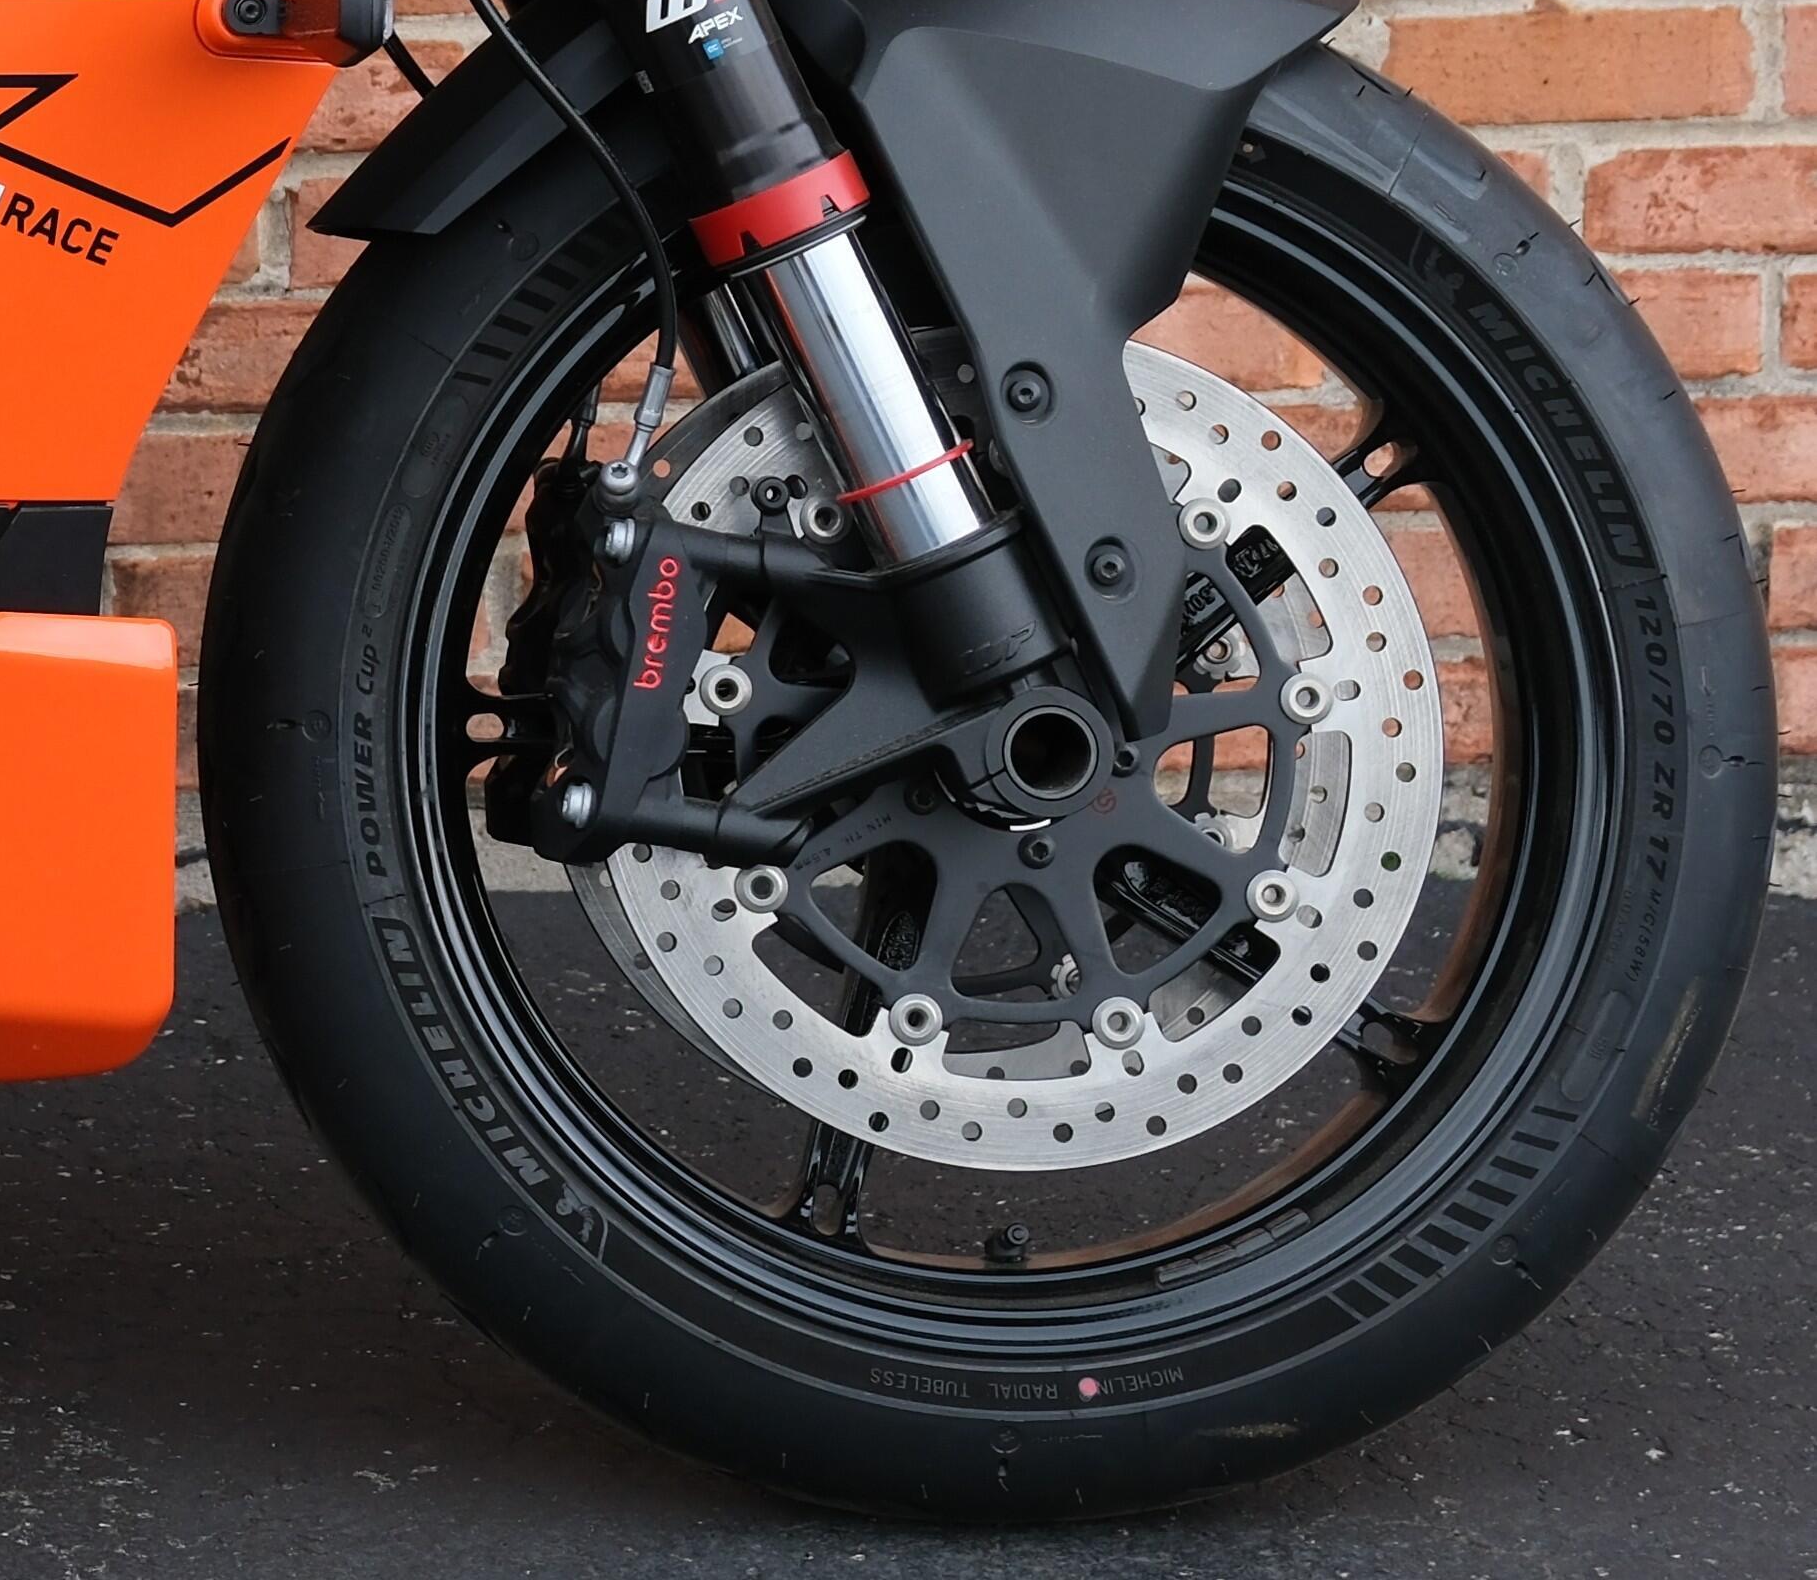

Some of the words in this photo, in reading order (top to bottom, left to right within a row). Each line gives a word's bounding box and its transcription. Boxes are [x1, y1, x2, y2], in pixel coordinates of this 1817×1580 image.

[687, 5, 744, 45] APEX
[0, 192, 120, 267] RACE
[1467, 301, 1646, 558] MICHELIN
[632, 557, 681, 690] brembo
[355, 643, 381, 696] Cup
[1633, 595, 1676, 747] 120/70
[353, 711, 389, 878] POWER
[1651, 760, 1677, 822] ZR
[1645, 834, 1670, 884] 17
[381, 927, 552, 1187] MICHELIN
[868, 1366, 972, 1399] TUBELESS
[988, 1381, 1060, 1401] RADIAL
[1096, 1366, 1184, 1396] MICHELIN
